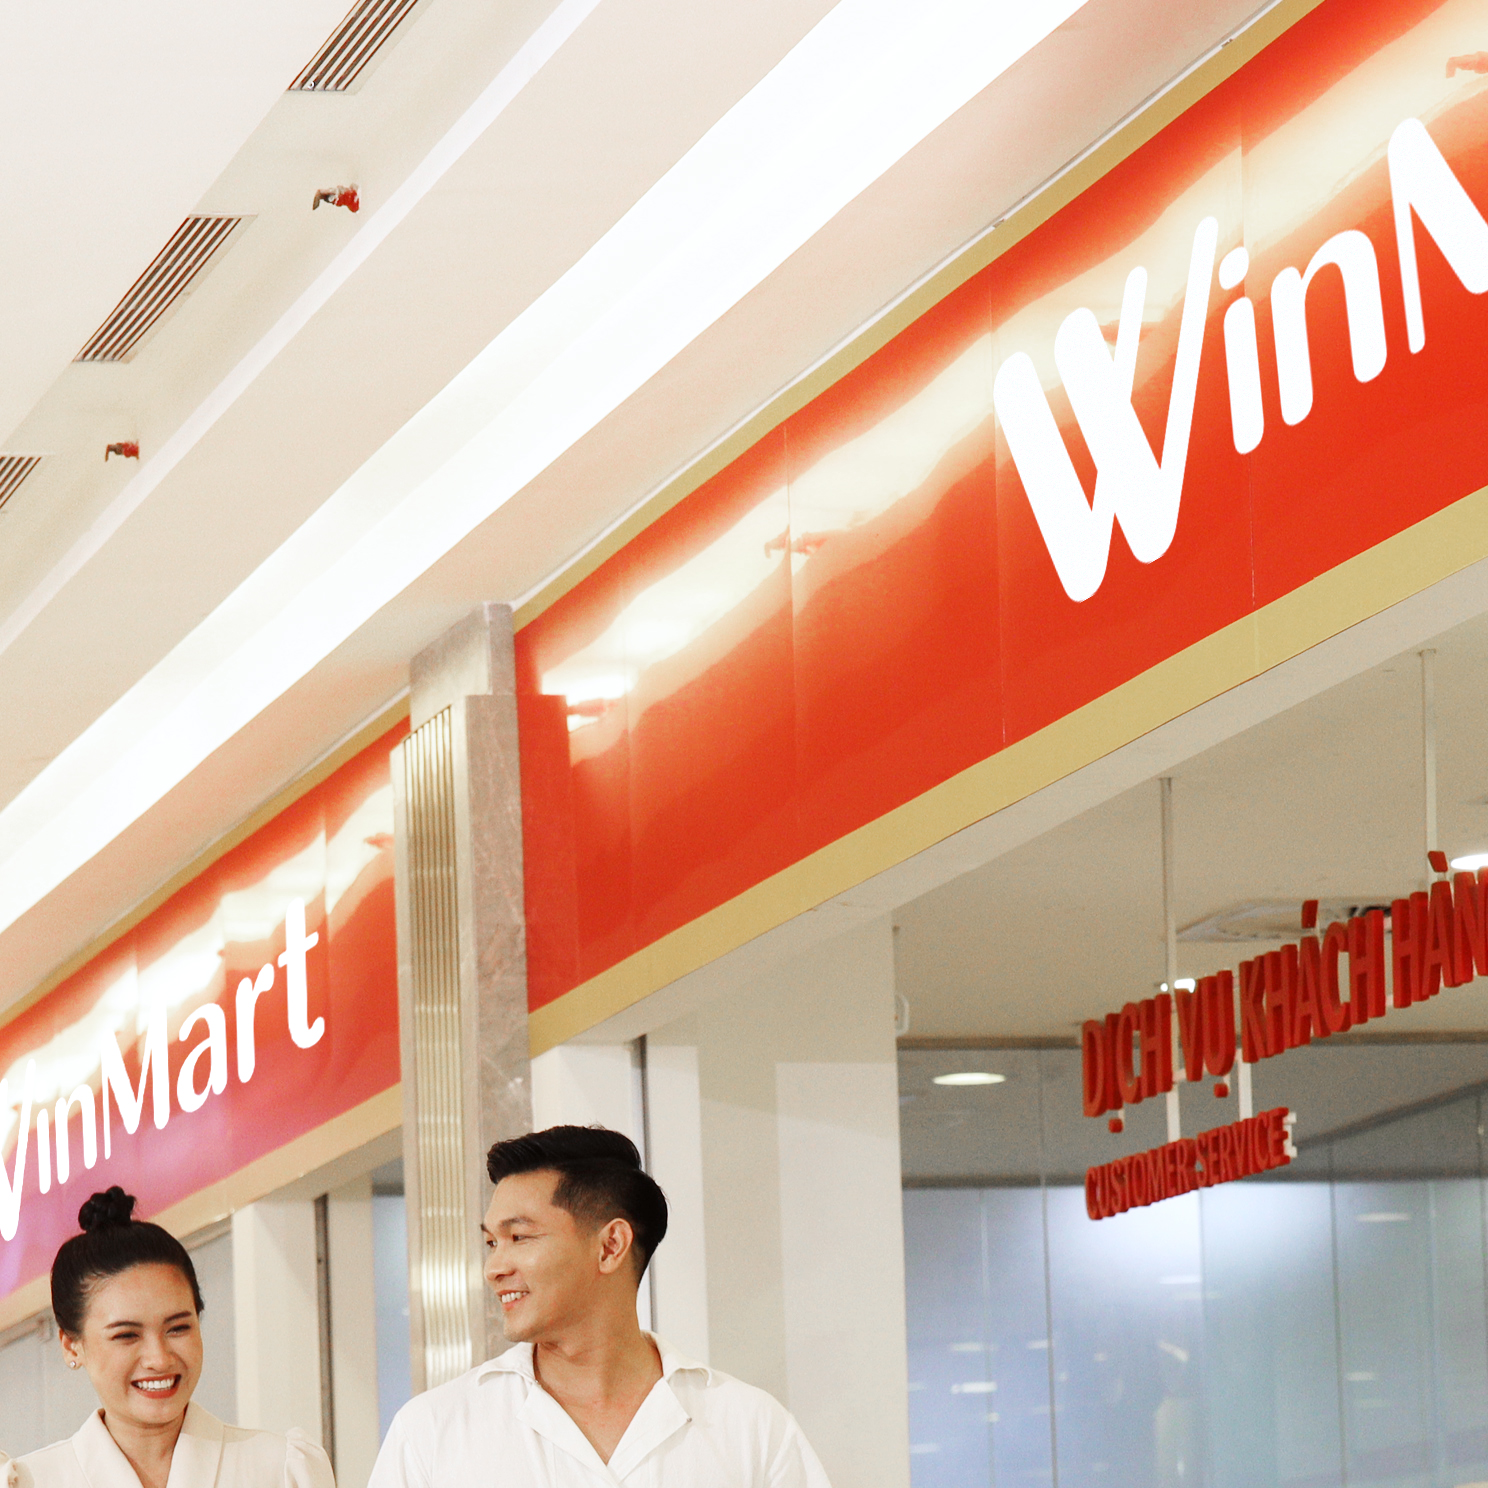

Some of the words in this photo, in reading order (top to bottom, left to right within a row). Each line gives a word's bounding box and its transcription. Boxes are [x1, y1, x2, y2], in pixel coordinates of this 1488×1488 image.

[1082, 993, 1175, 1134] DỊCH
[1174, 970, 1236, 1098] VỤ
[1239, 899, 1387, 1063] KHÁCH
[1084, 1138, 1199, 1221] CUSTOMER
[1194, 1106, 1290, 1189] SERVICE
